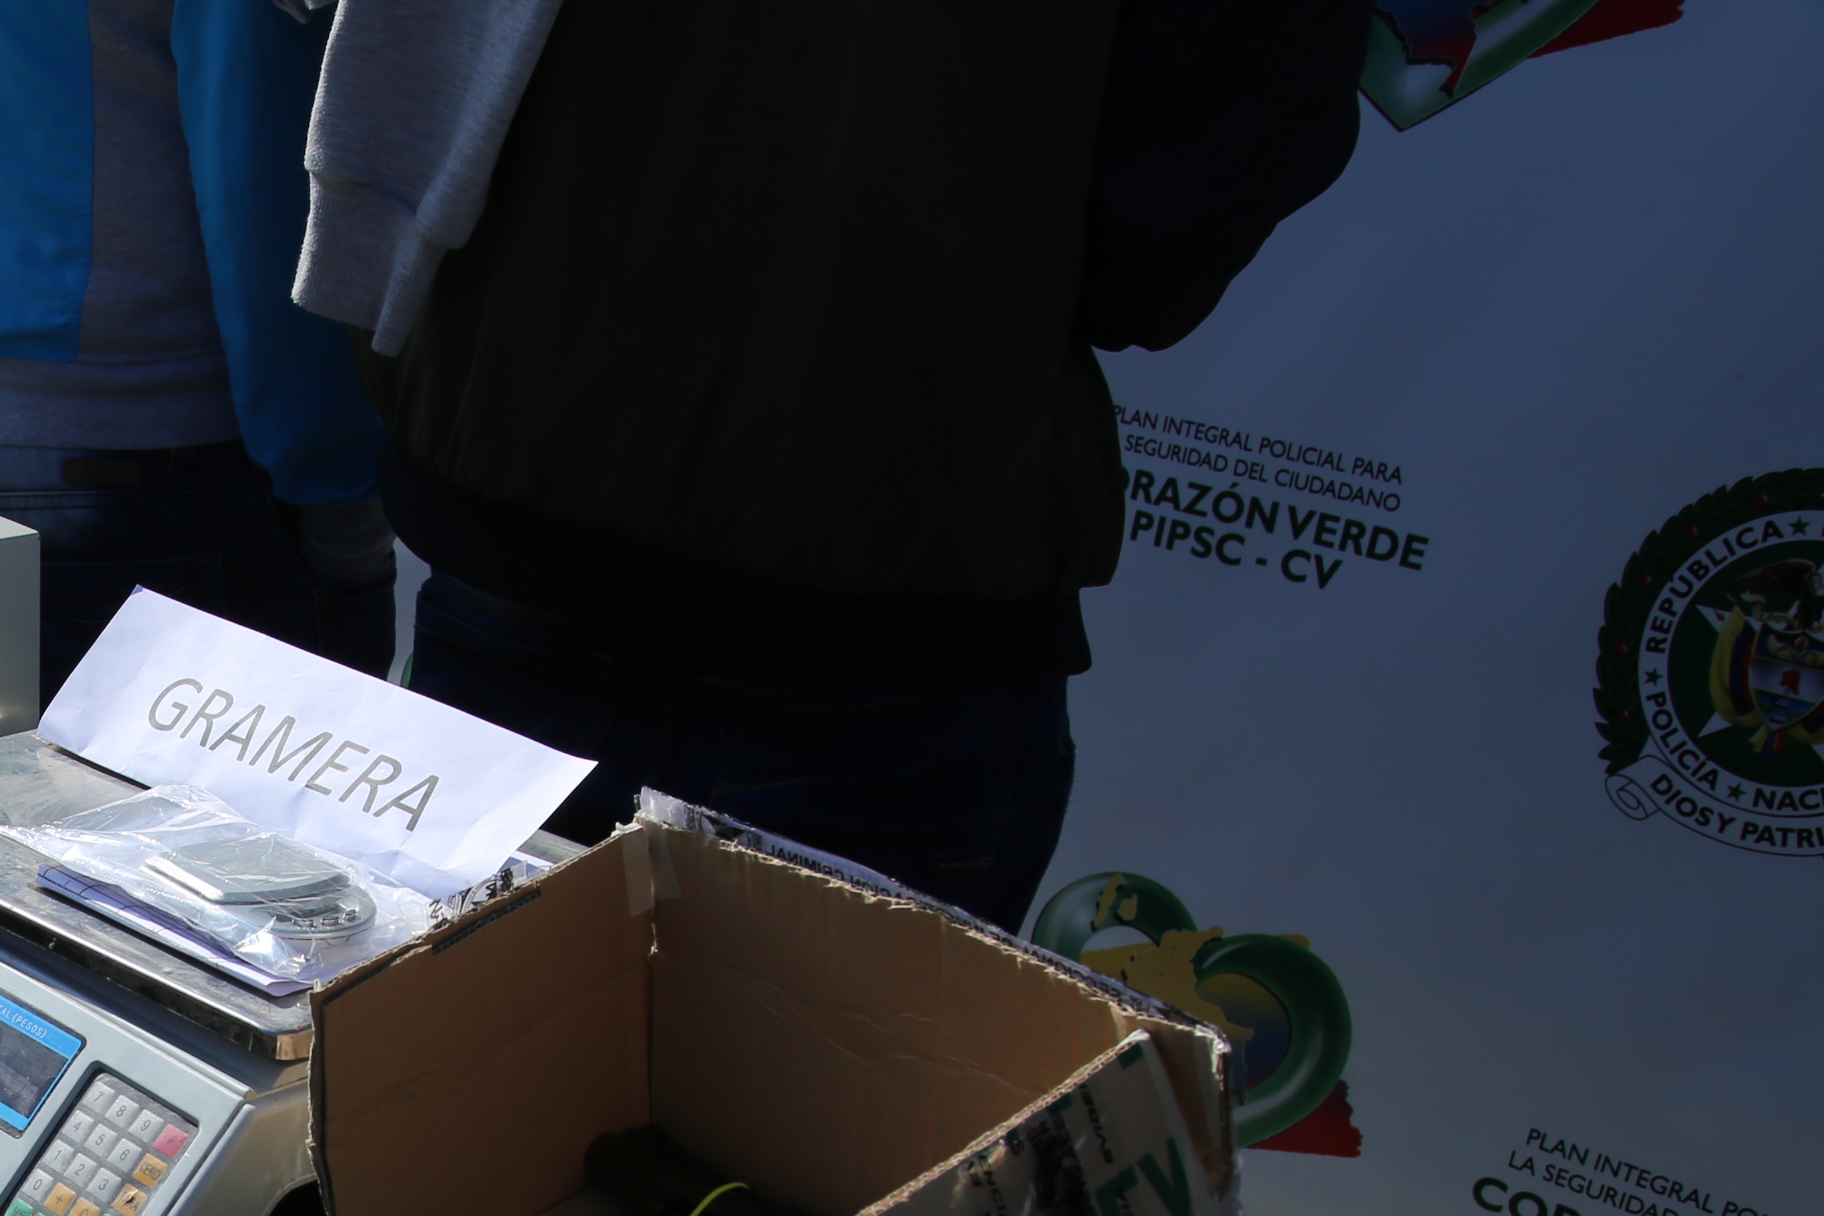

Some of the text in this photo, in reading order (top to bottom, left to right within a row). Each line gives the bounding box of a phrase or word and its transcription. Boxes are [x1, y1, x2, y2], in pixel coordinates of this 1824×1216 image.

[1124, 433, 1402, 513] SEGURIDAD DEL CIUDADANO
[1162, 416, 1253, 452] INTEGRAL
[1258, 436, 1346, 473] POLICIAL
[1351, 456, 1402, 486] PARA
[1122, 466, 1430, 572] RAZÓN VERDE
[1129, 509, 1246, 567] PIPSC
[1280, 548, 1344, 590] CV
[1644, 519, 1785, 655] REPÚBLICA
[147, 676, 442, 833] GRAMERA
[1645, 691, 1824, 812] POLICÍA NACI
[1649, 773, 1715, 828] DIOS
[1739, 820, 1824, 849] PATRI
[11, 1013, 48, 1039] (PESOS)
[72, 1120, 82, 1133] 4
[94, 1133, 106, 1146] 5
[119, 1149, 130, 1161] 6
[115, 1105, 127, 1118] 8
[140, 1119, 151, 1132] 9
[32, 1179, 44, 1191] 0
[73, 1163, 85, 1176] 2
[98, 1178, 109, 1191] 3
[1507, 1149, 1536, 1177] LA
[1525, 1127, 1590, 1167] PLAN
[1593, 1152, 1715, 1215] INTEGRAL
